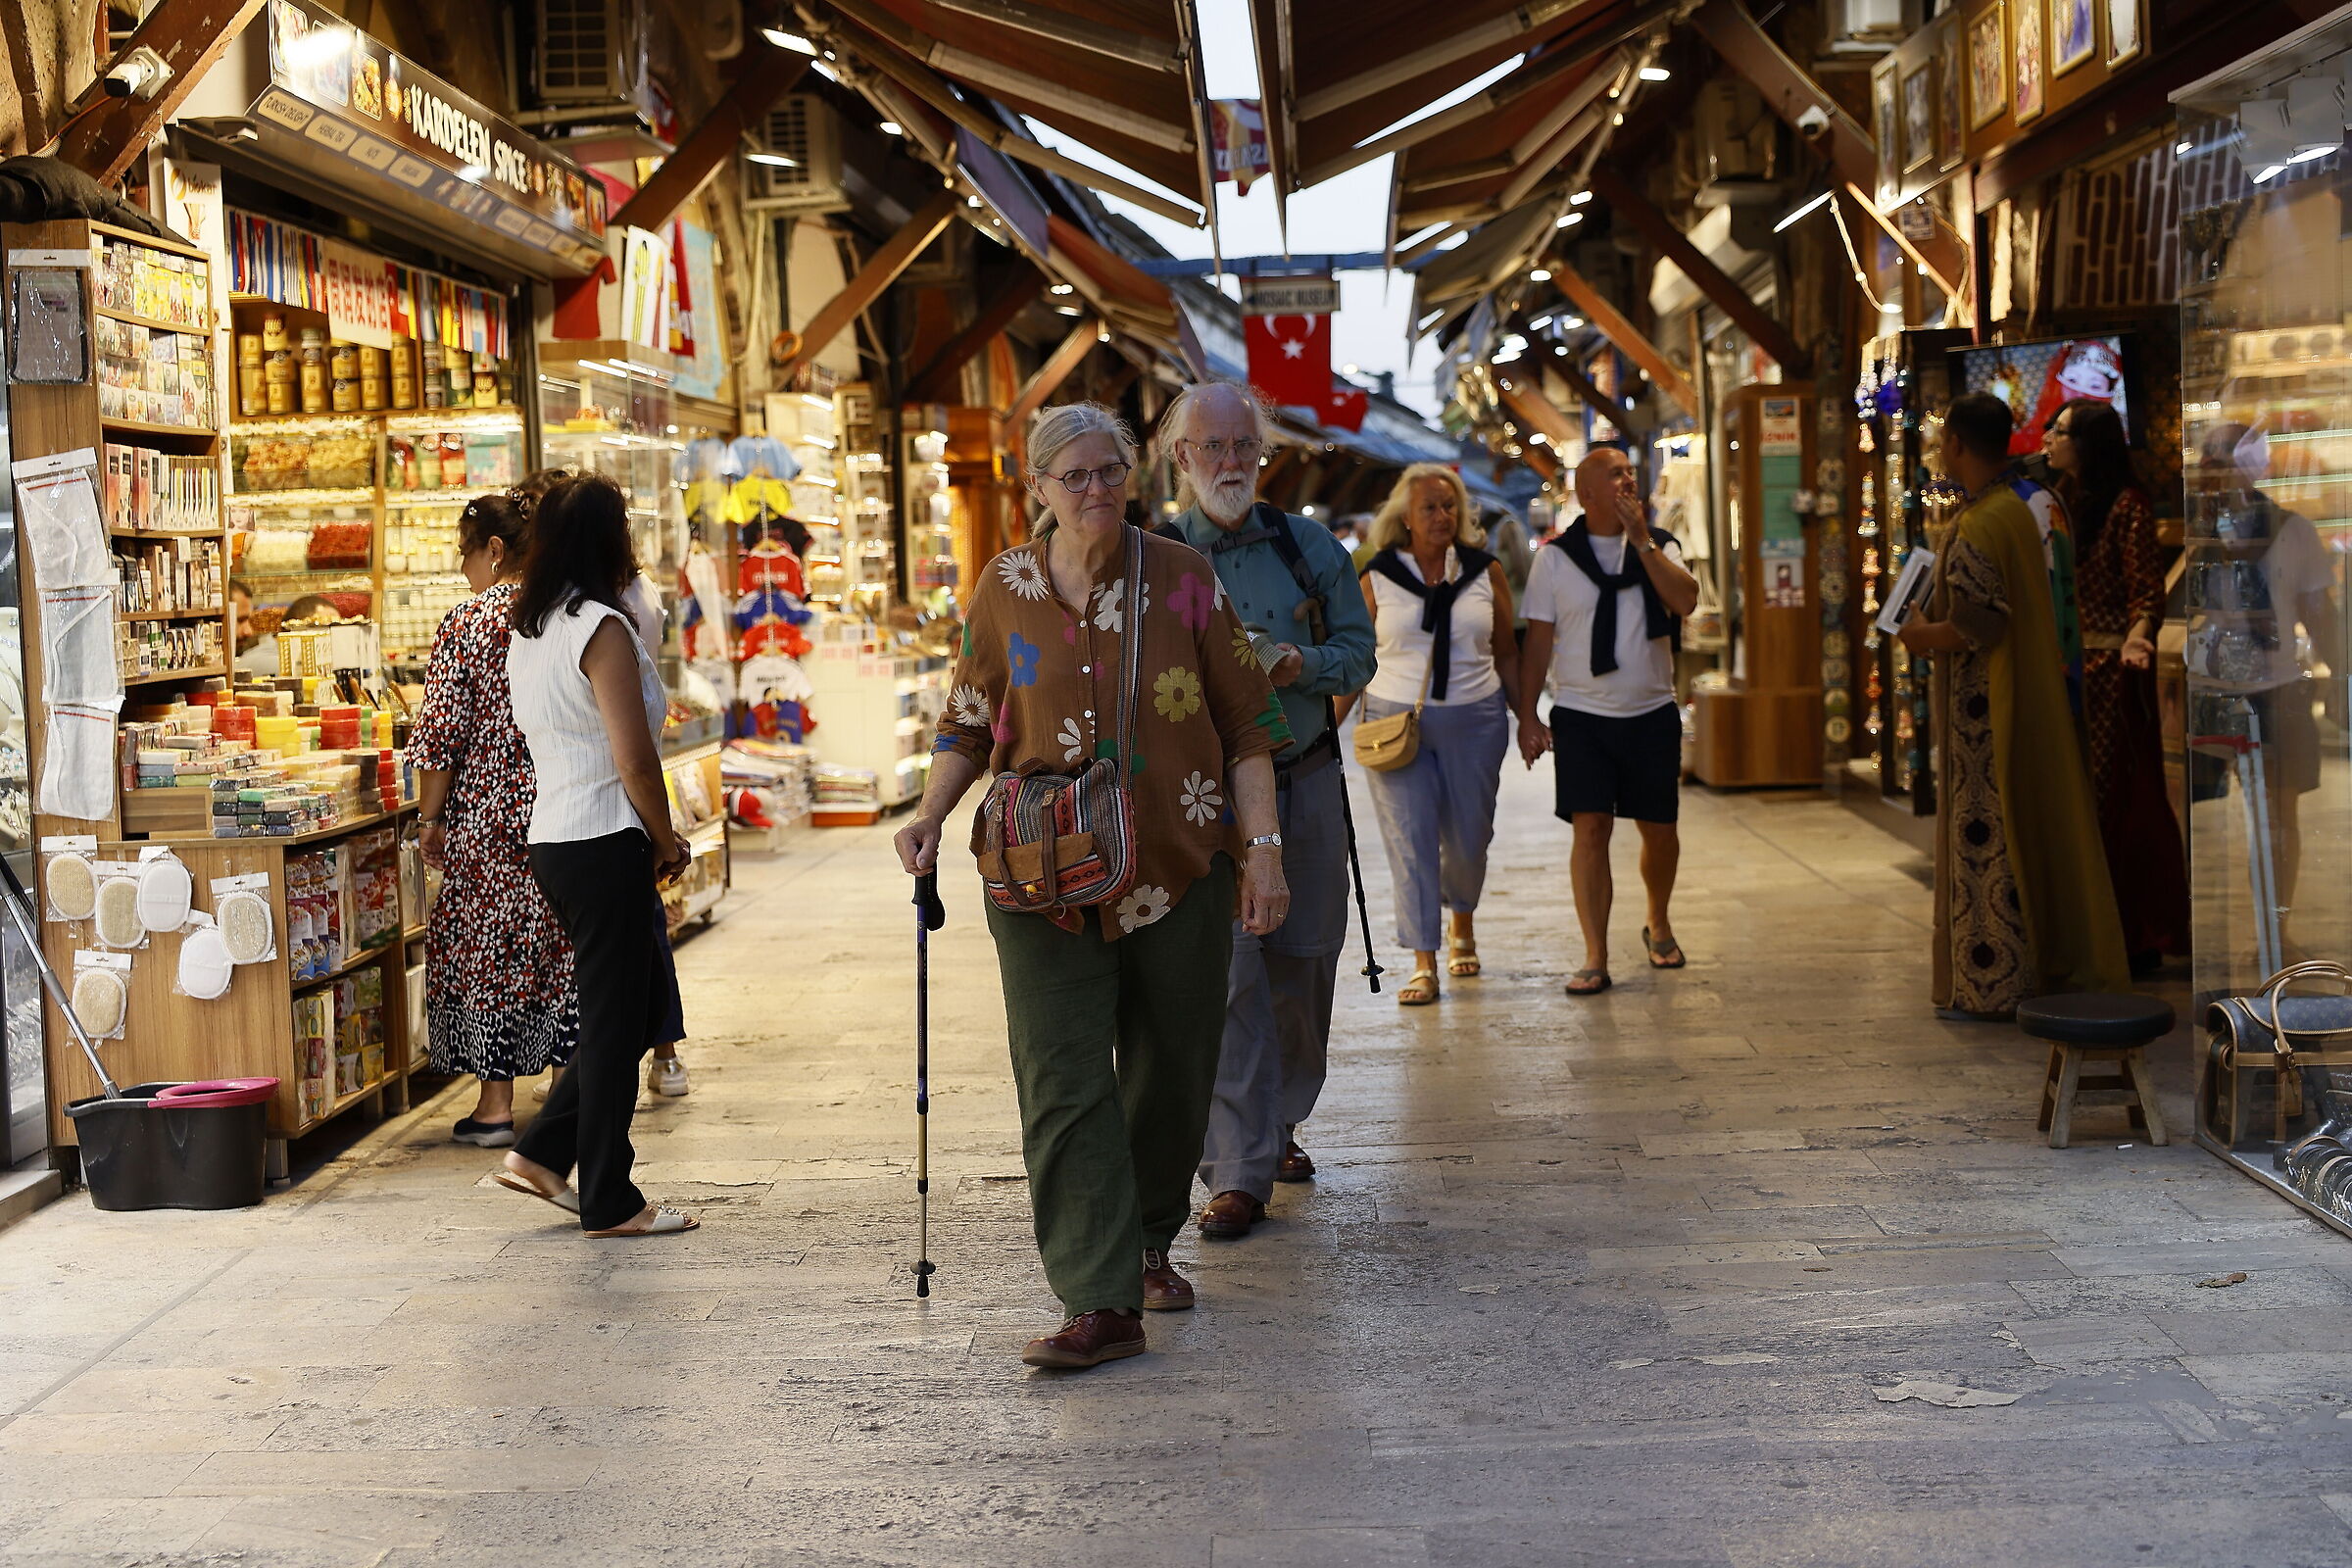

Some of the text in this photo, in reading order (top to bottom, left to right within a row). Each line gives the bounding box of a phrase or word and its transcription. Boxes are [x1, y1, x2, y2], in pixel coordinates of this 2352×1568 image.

[264, 95, 309, 123] TURKISH DELIGHT
[411, 82, 528, 194] KARDELEN SPICE
[1297, 288, 1336, 307] MUSEUM
